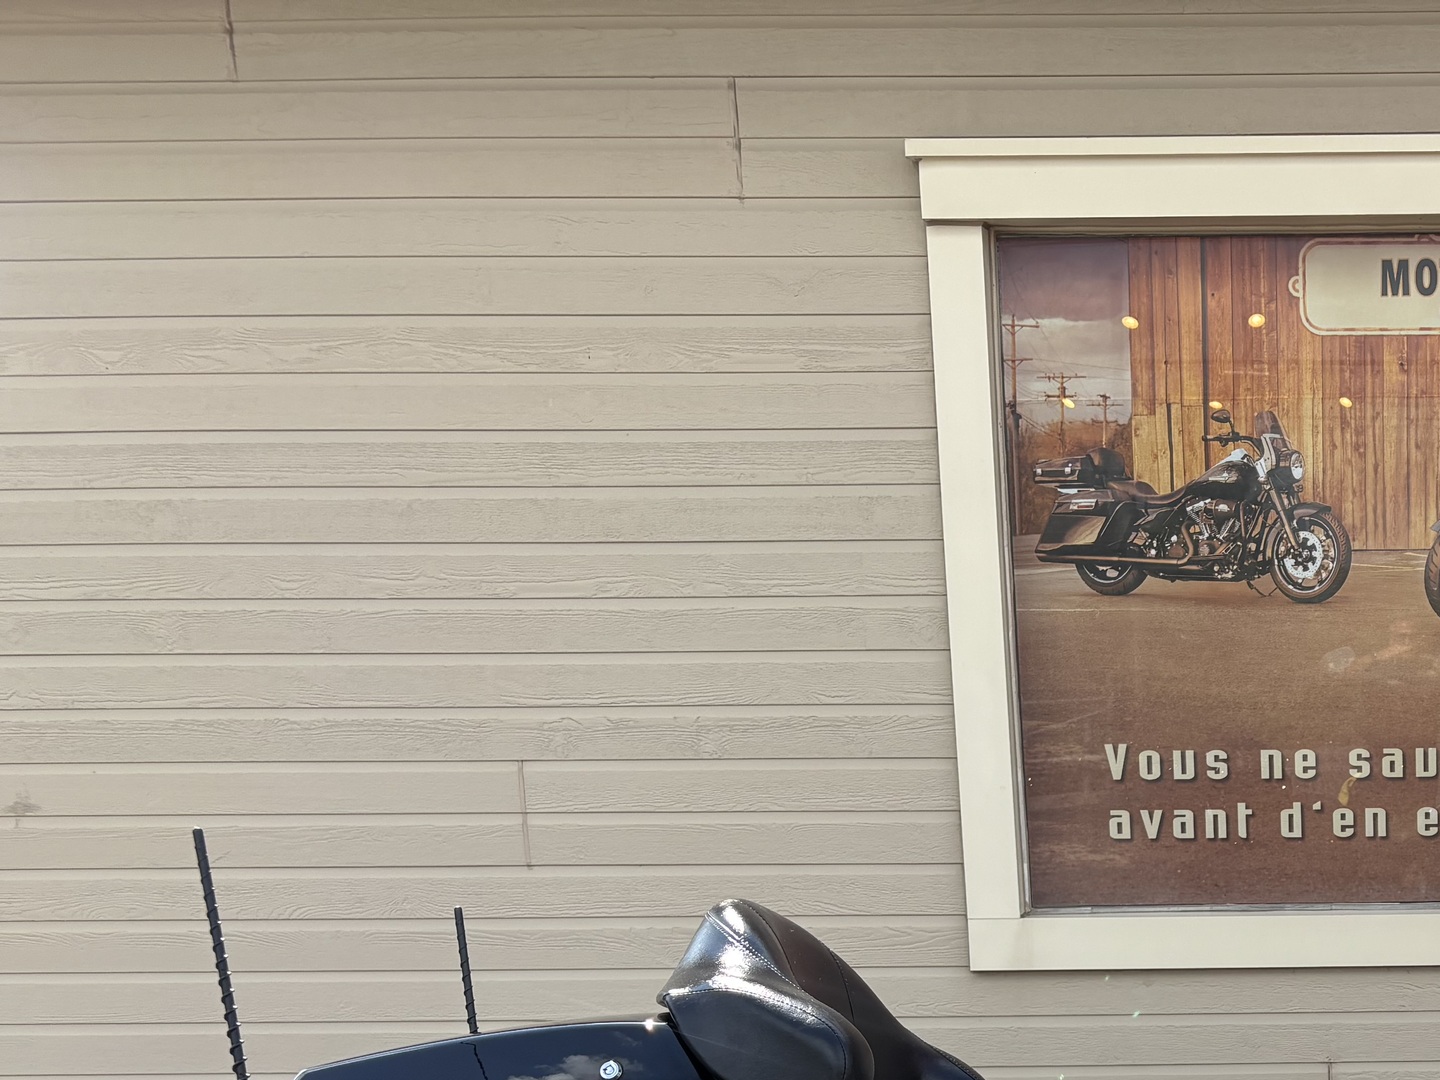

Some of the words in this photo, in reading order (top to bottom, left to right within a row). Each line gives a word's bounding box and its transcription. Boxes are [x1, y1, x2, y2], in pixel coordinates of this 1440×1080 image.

[1104, 743, 1228, 781] Vous
[1260, 749, 1317, 779] ne
[1108, 802, 1253, 839] avant
[1280, 801, 1387, 838] d'en
